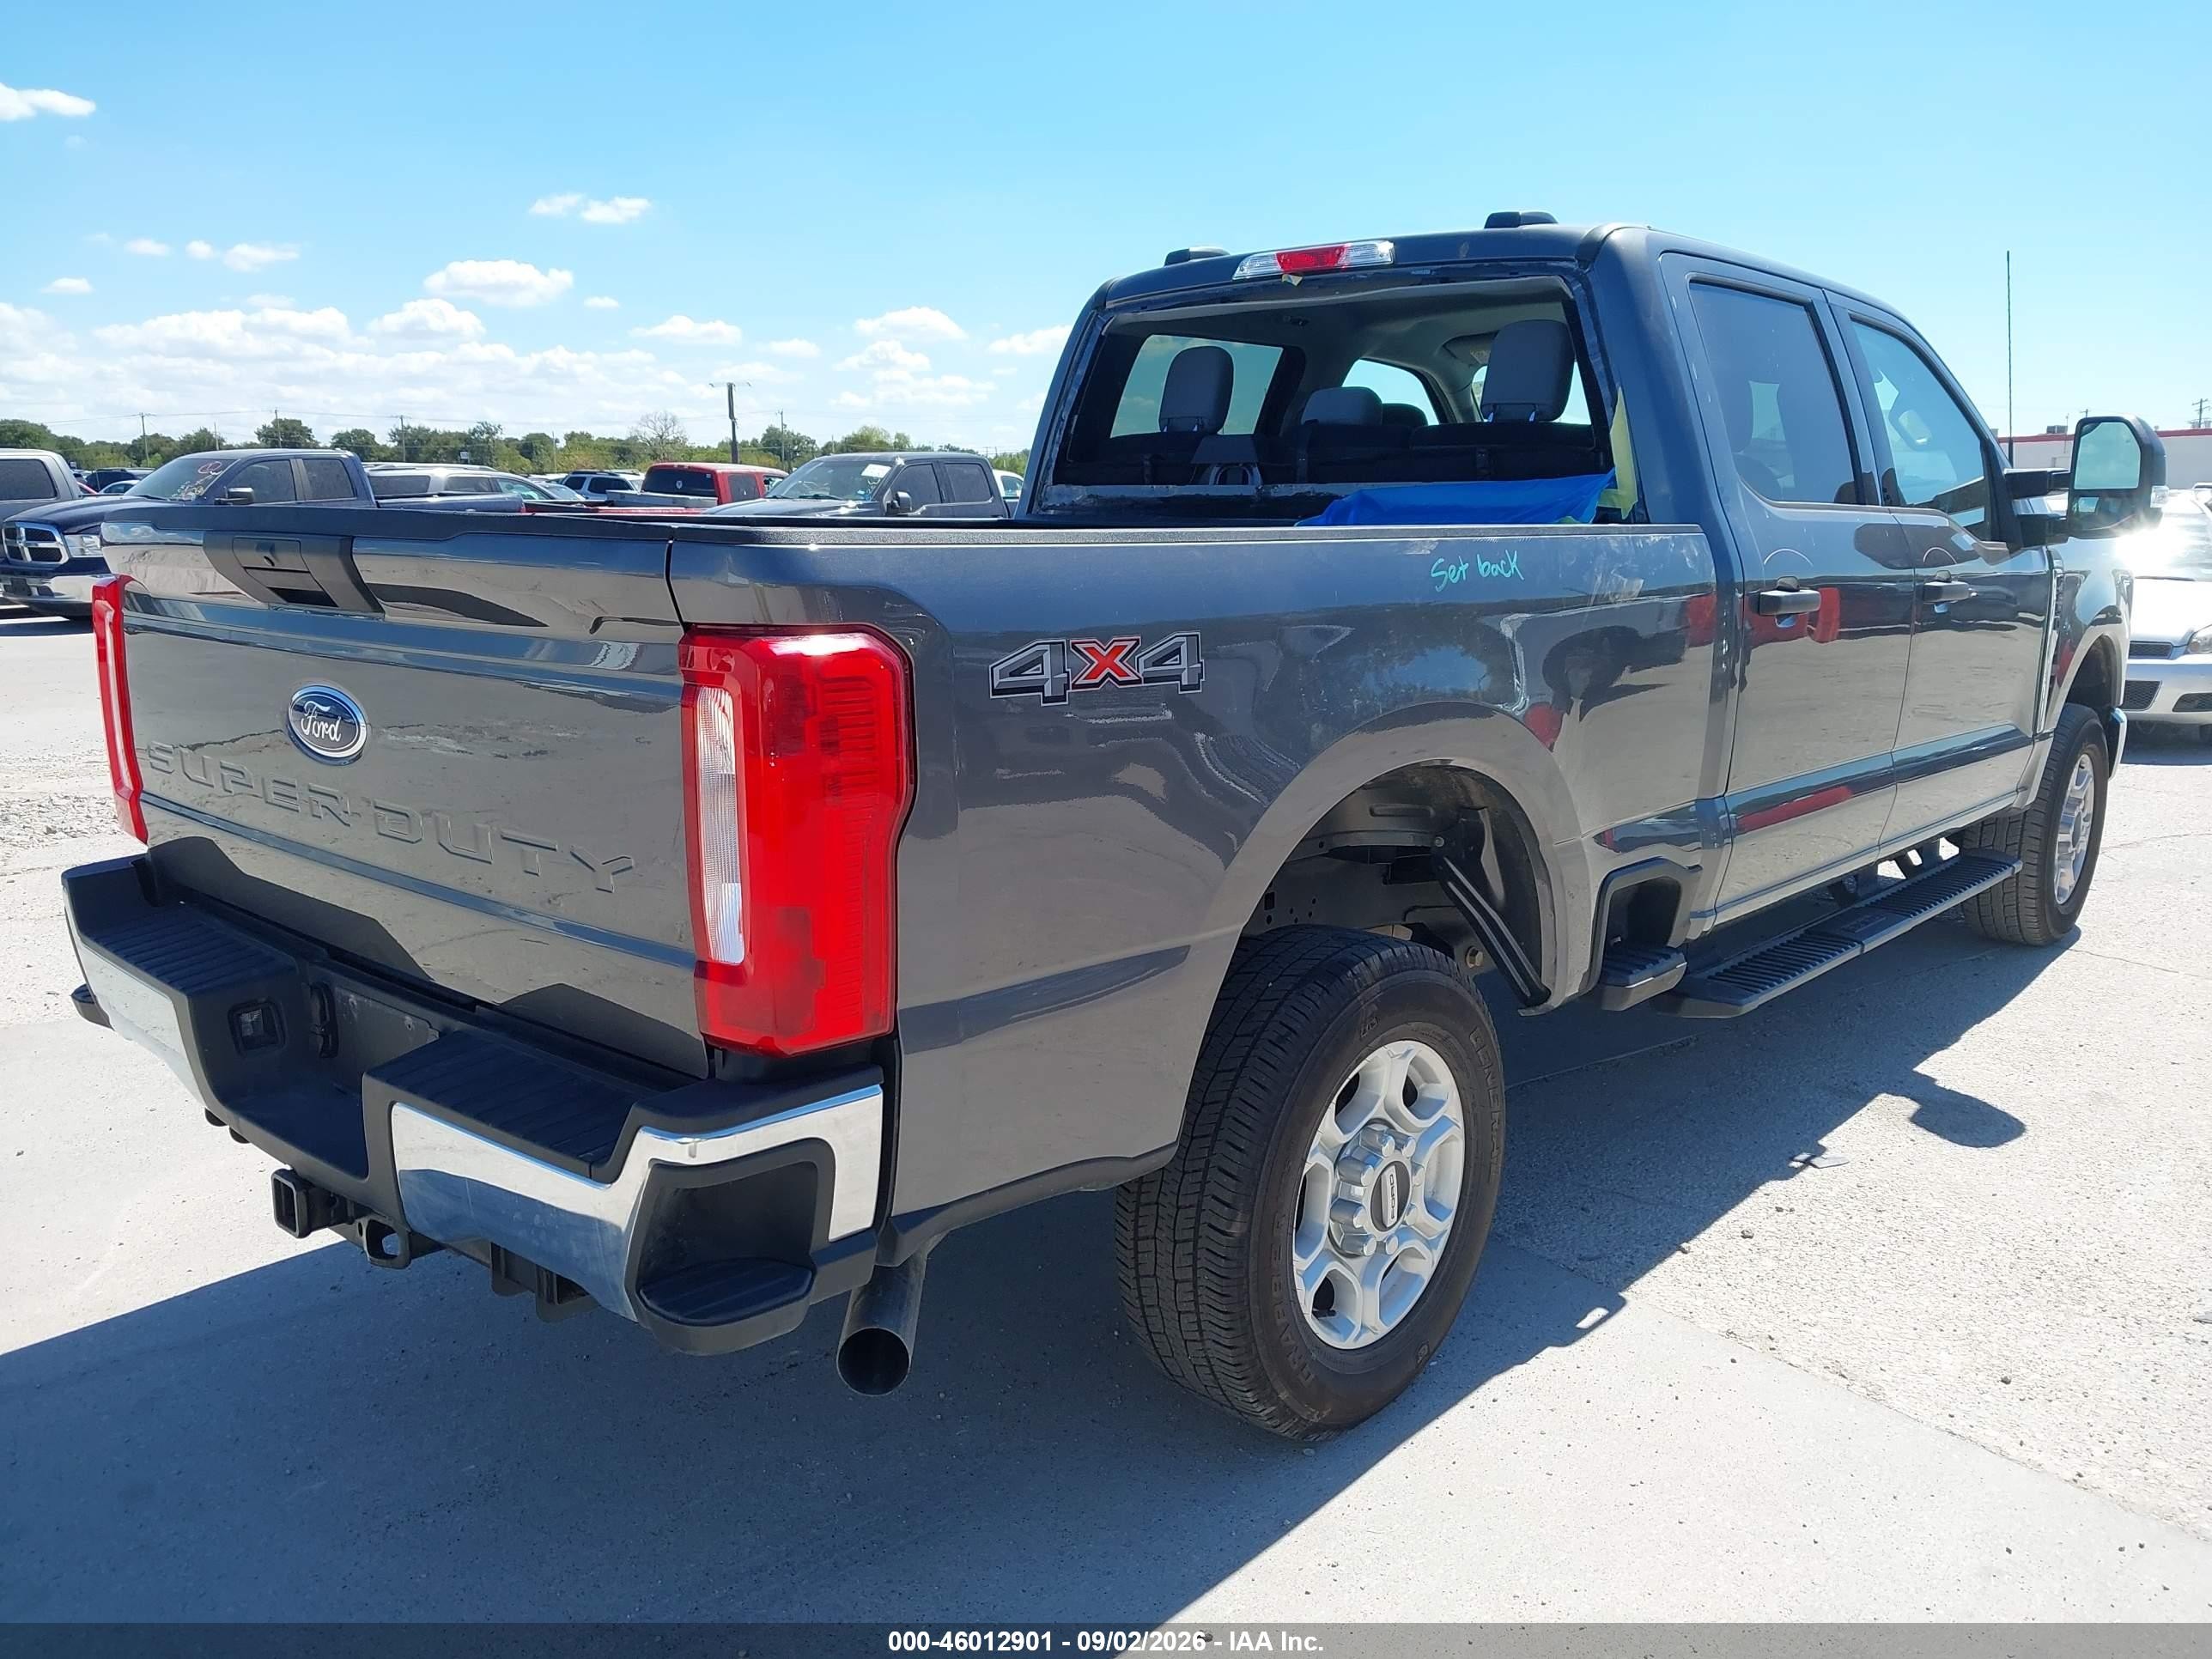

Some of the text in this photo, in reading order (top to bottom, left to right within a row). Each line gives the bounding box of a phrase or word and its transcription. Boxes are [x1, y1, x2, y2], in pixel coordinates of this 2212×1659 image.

[1430, 556, 1469, 592] Set
[301, 700, 342, 742] Ford
[148, 740, 634, 894] SUPER DUTY
[1468, 1025, 1503, 1185] GENERAL
